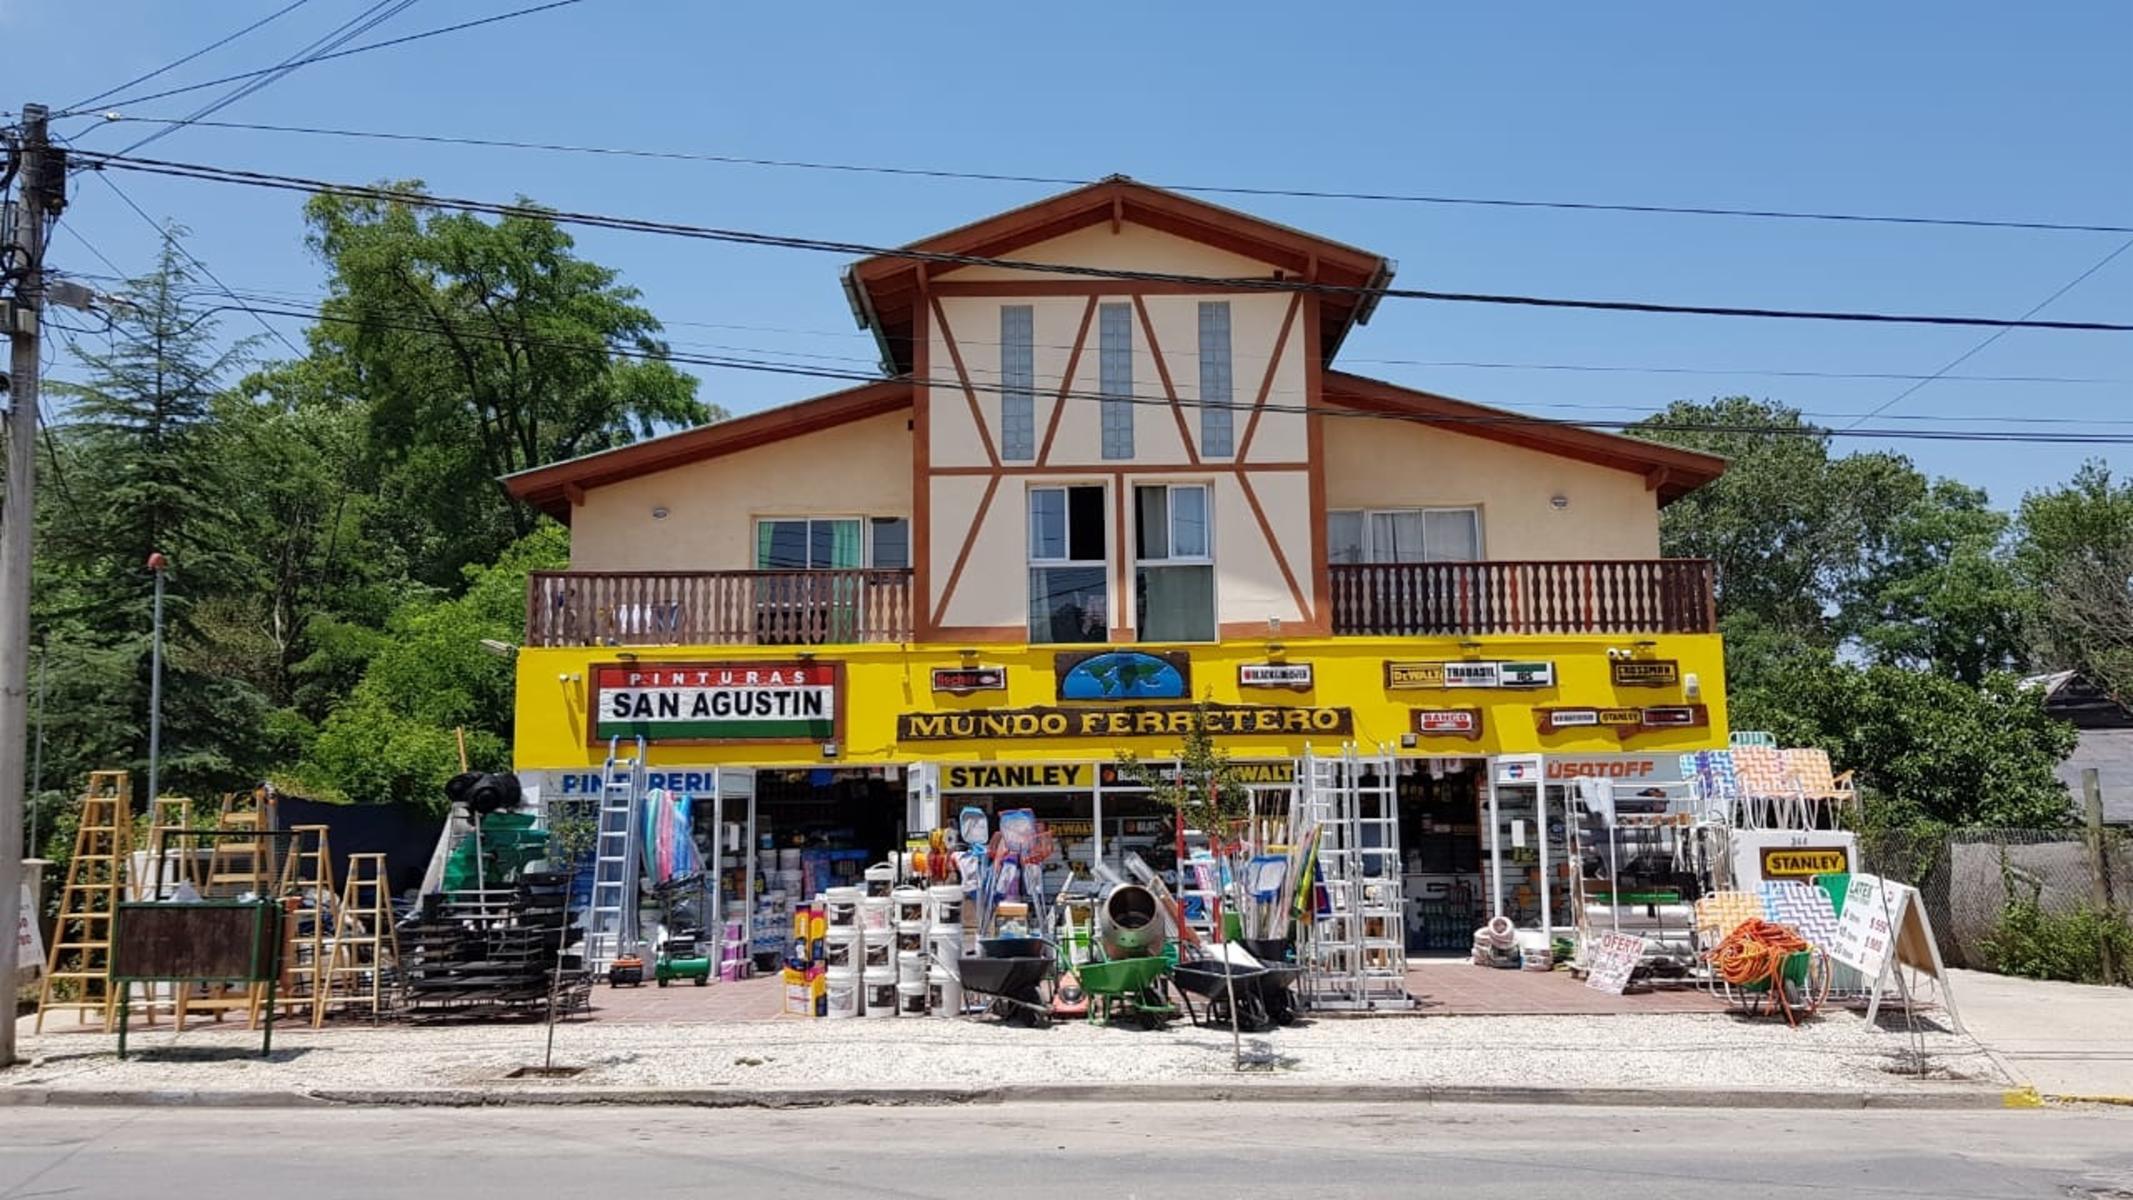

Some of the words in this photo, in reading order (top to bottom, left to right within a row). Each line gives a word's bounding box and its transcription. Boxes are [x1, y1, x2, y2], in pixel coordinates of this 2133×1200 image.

[630, 671, 805, 685] PINTURAS
[613, 692, 679, 718] SAN
[691, 690, 822, 717] AGUSTIN
[908, 714, 1068, 736] MUNDO
[1080, 709, 1339, 733] FERRETERO
[951, 765, 1080, 788] STANLEY
[1772, 856, 1840, 870] STANLEY
